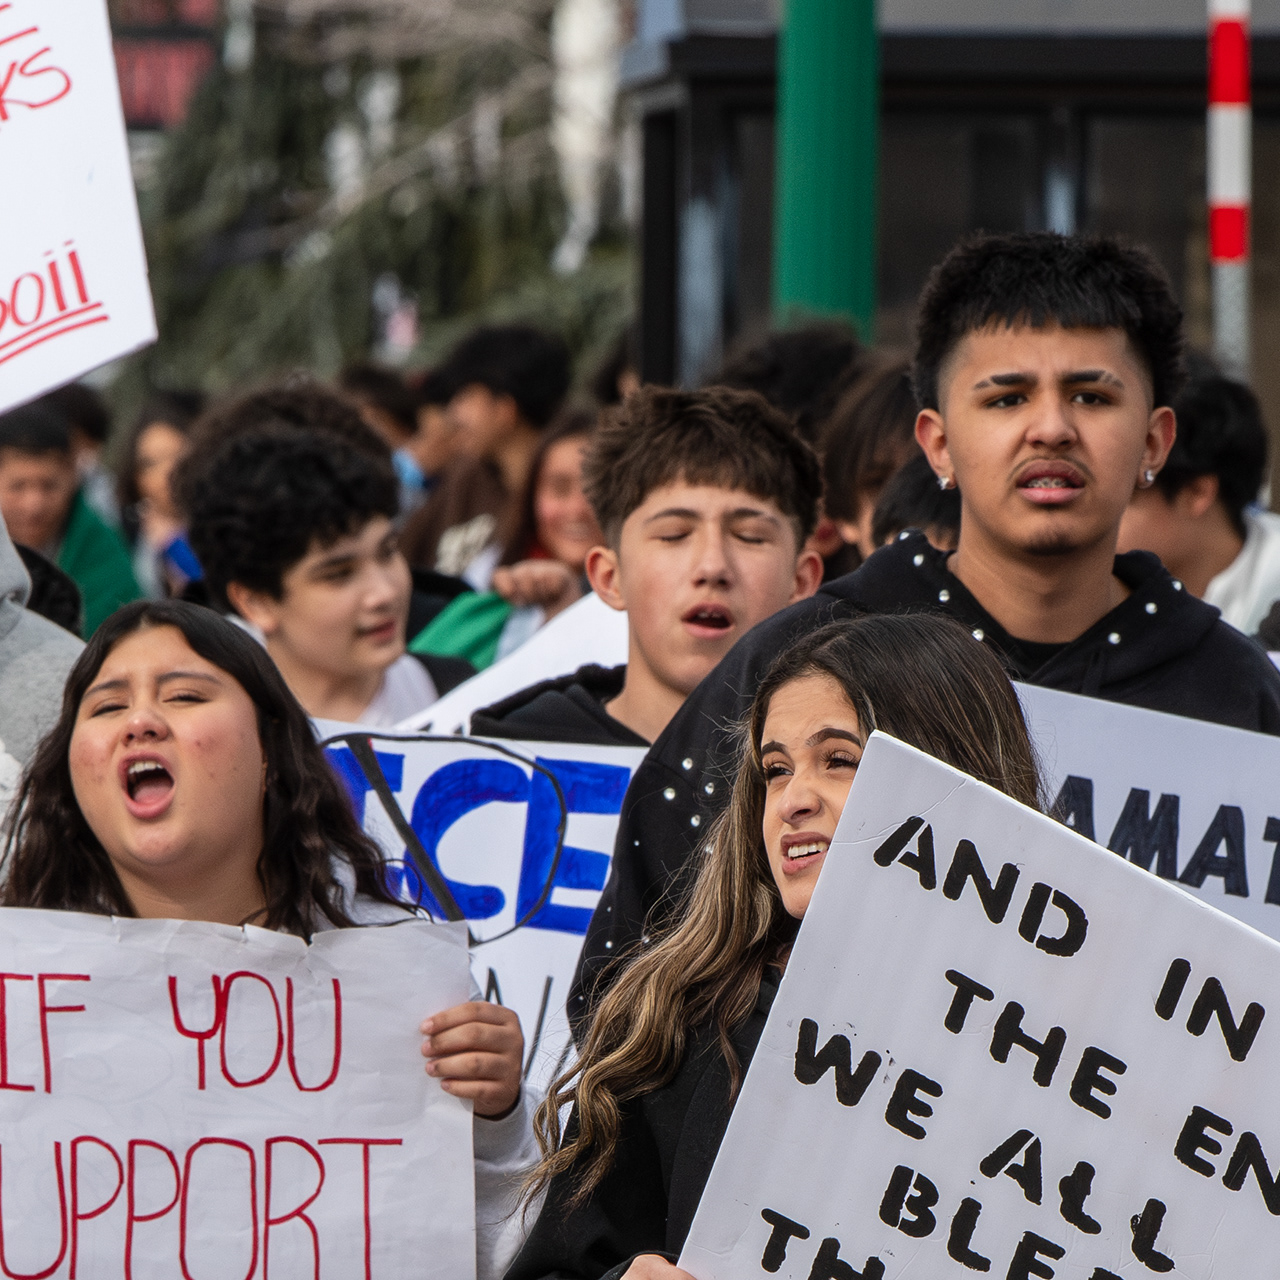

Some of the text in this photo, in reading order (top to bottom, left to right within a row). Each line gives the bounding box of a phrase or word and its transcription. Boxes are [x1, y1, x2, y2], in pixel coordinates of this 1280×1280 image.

[167, 970, 342, 1093] YOU
[872, 815, 1090, 958] AND
[1155, 958, 1266, 1063] IN
[944, 970, 1128, 1119] THE
[794, 1018, 1176, 1274] WE ALL
